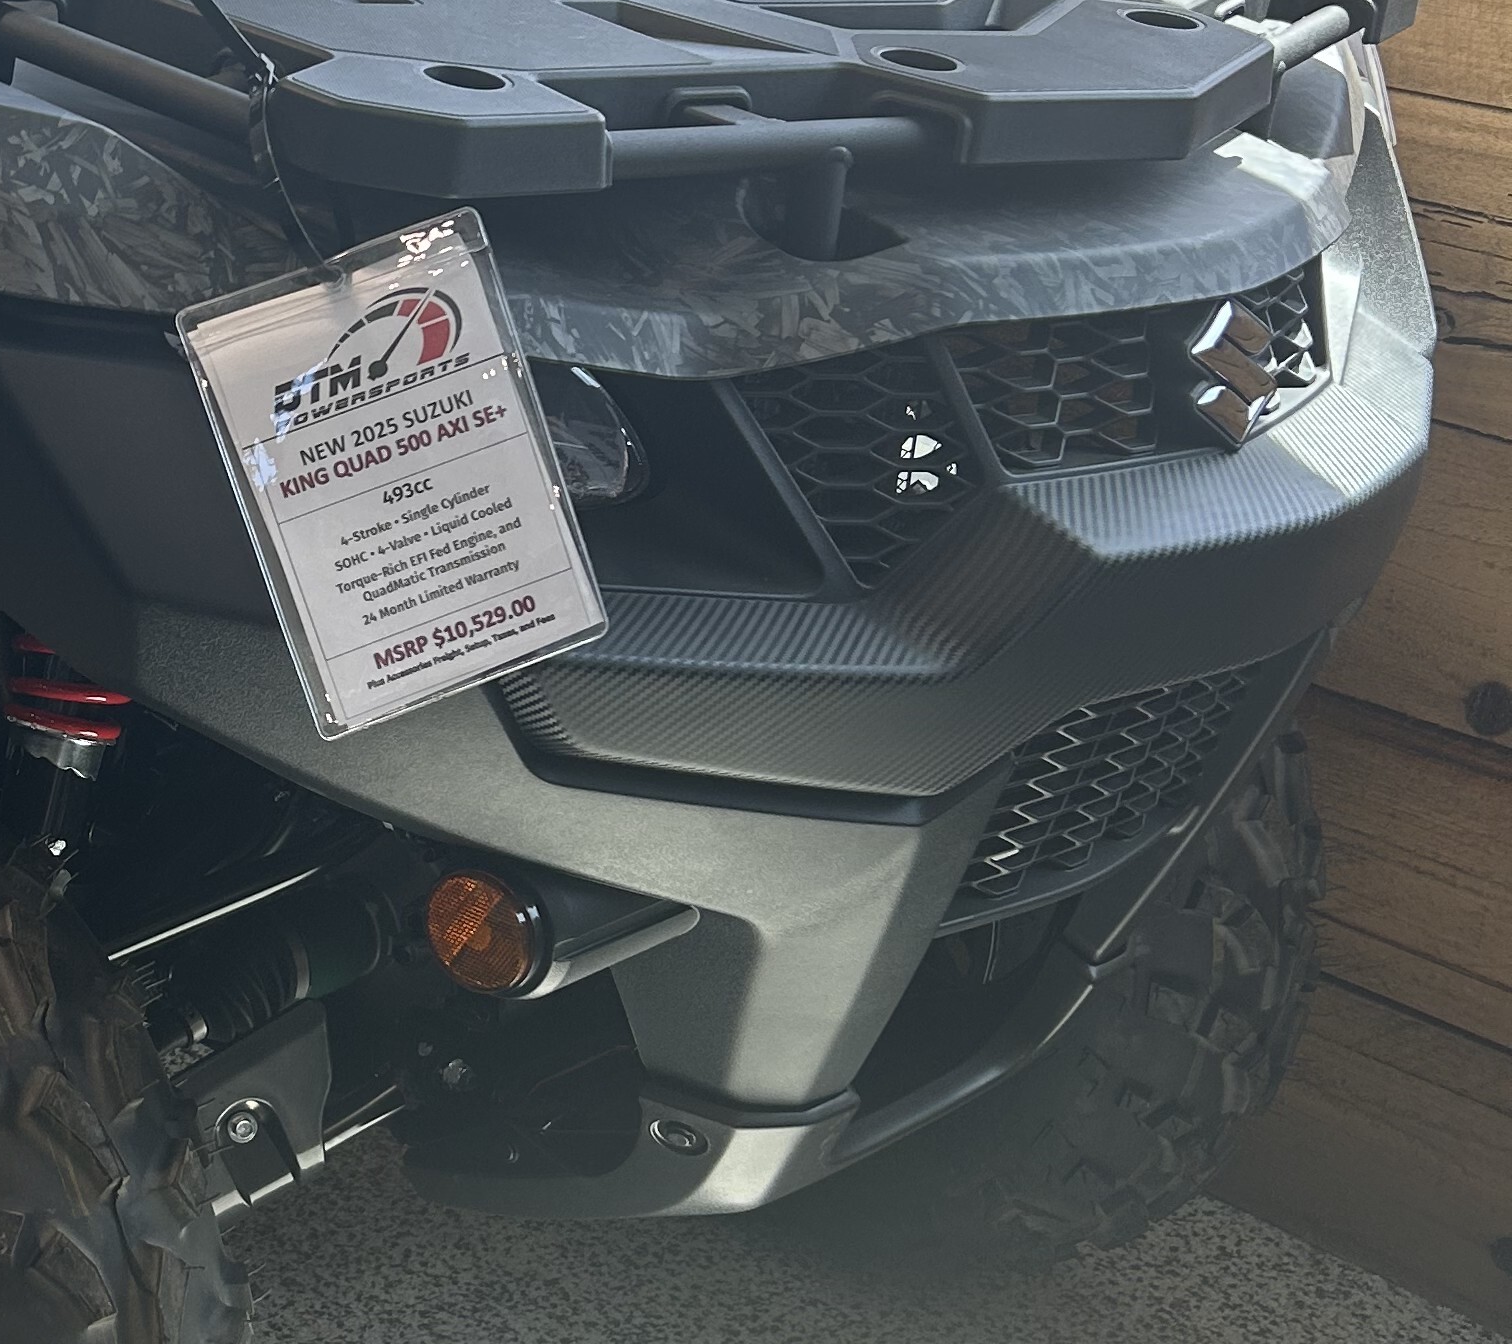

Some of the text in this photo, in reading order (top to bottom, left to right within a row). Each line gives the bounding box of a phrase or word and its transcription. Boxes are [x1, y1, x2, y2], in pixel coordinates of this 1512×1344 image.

[275, 353, 470, 434] POWERSPORTS
[299, 389, 474, 466] NEW 2025 SUZUKI
[279, 402, 508, 499] KING QUAD 500 AXI SE+
[340, 484, 491, 546] 4-Stroke Single Cylinder
[382, 478, 434, 505] 493cc
[334, 497, 513, 572] SOHC 4-Valve Liquid Cooled
[335, 516, 522, 594] Torque-Rich EFI Fed Engine, and
[362, 541, 507, 602] QuadMatic Transmission
[362, 559, 520, 626] 24 Month Limited Warranty
[372, 595, 536, 670] MSRP $10,529.00
